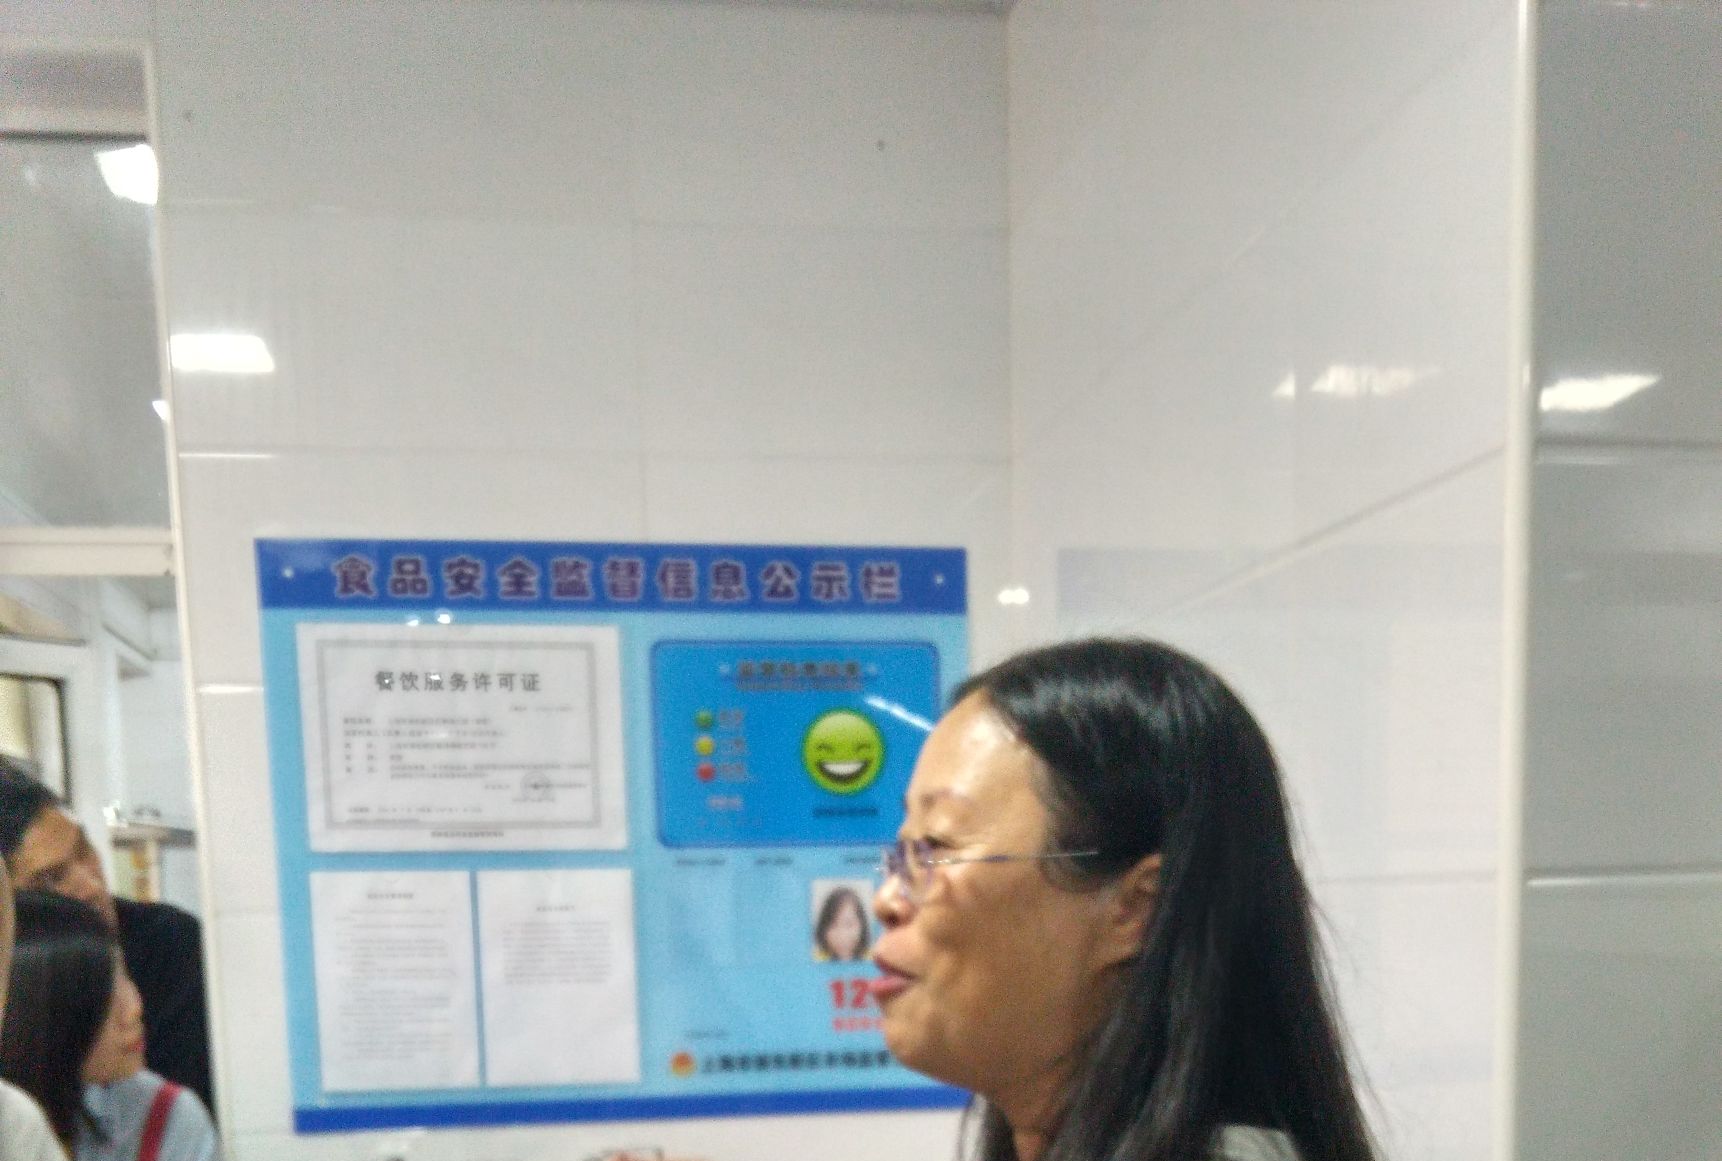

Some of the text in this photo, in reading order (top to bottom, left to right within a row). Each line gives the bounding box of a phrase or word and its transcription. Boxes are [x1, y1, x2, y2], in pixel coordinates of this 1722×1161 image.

[333, 555, 900, 600] 食品安全监督信息公示栏
[375, 670, 541, 692] 餐饮服务许可证
